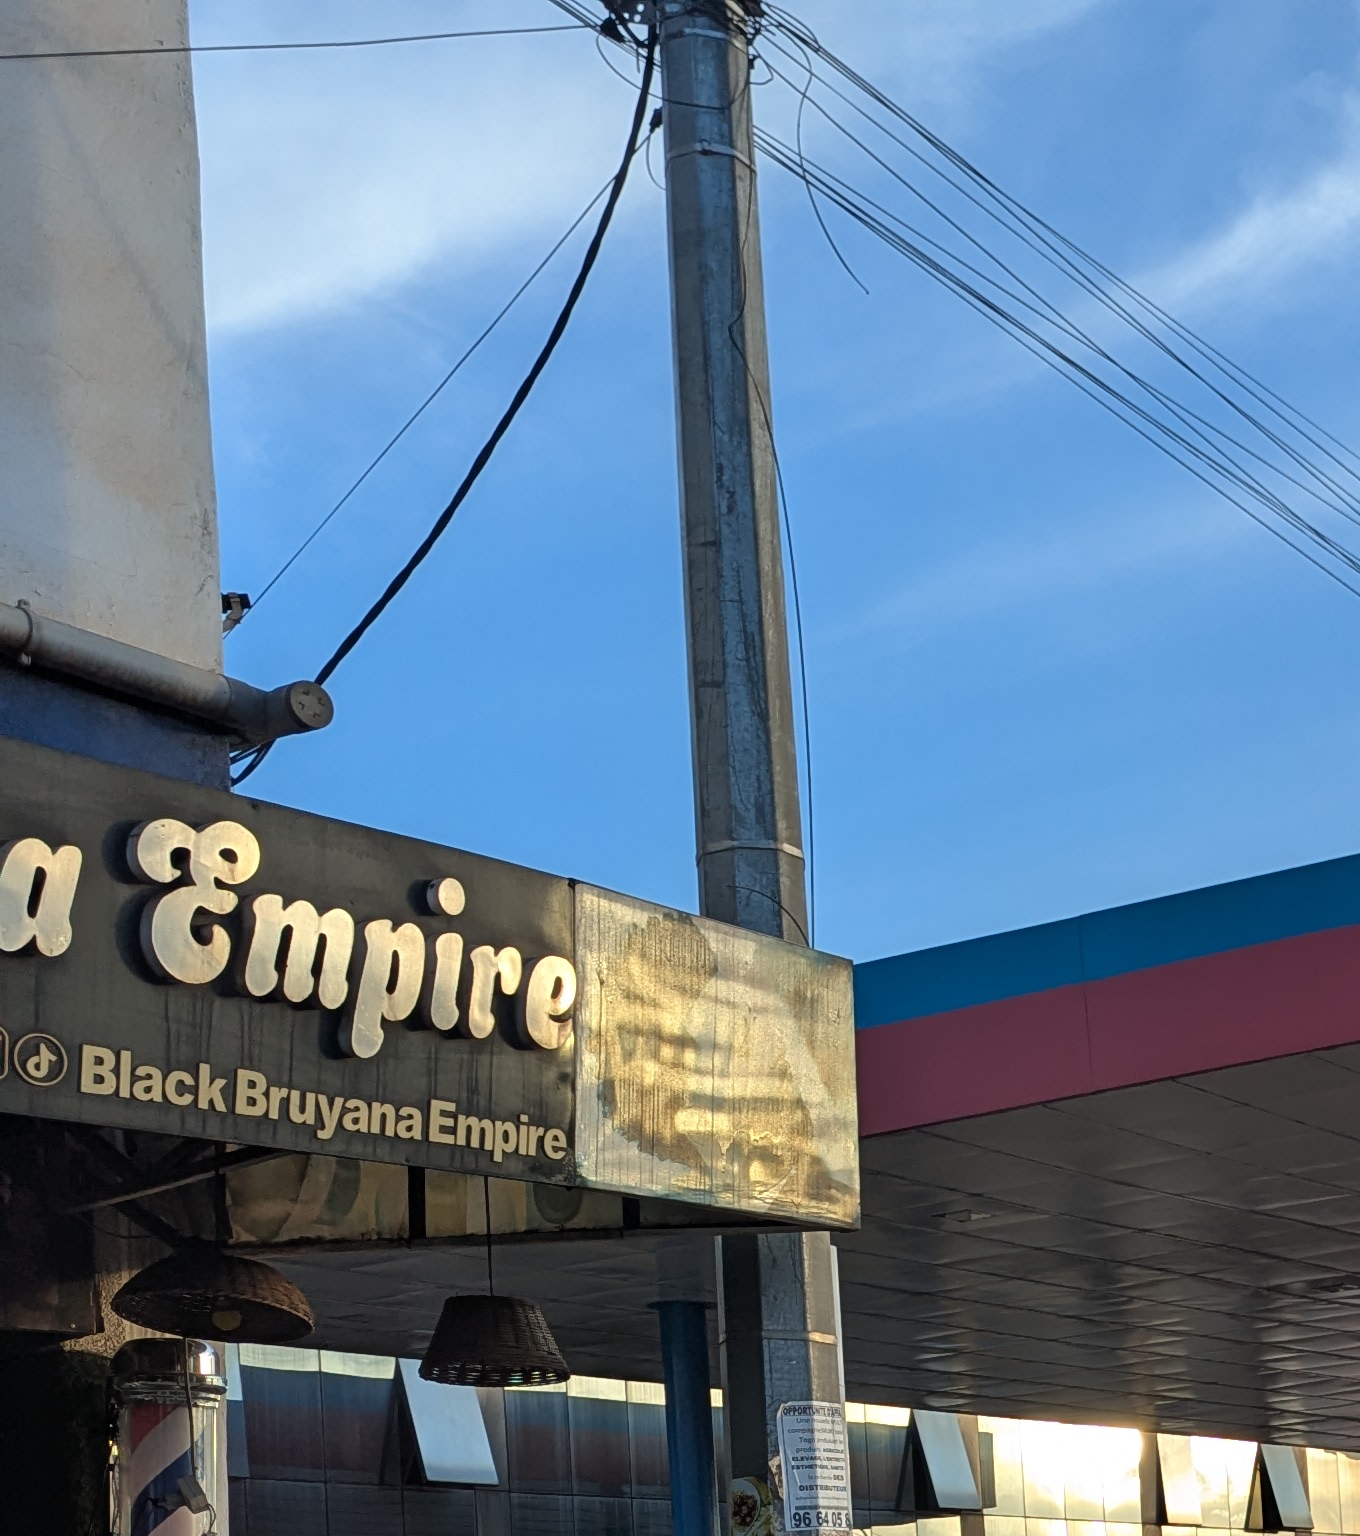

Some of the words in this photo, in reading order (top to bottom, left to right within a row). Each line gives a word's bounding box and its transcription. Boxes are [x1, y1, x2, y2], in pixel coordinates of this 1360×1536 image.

[128, 818, 577, 1059] Empire
[792, 1511, 812, 1528] 96
[816, 1510, 829, 1526] 64
[831, 1511, 842, 1527] 05
